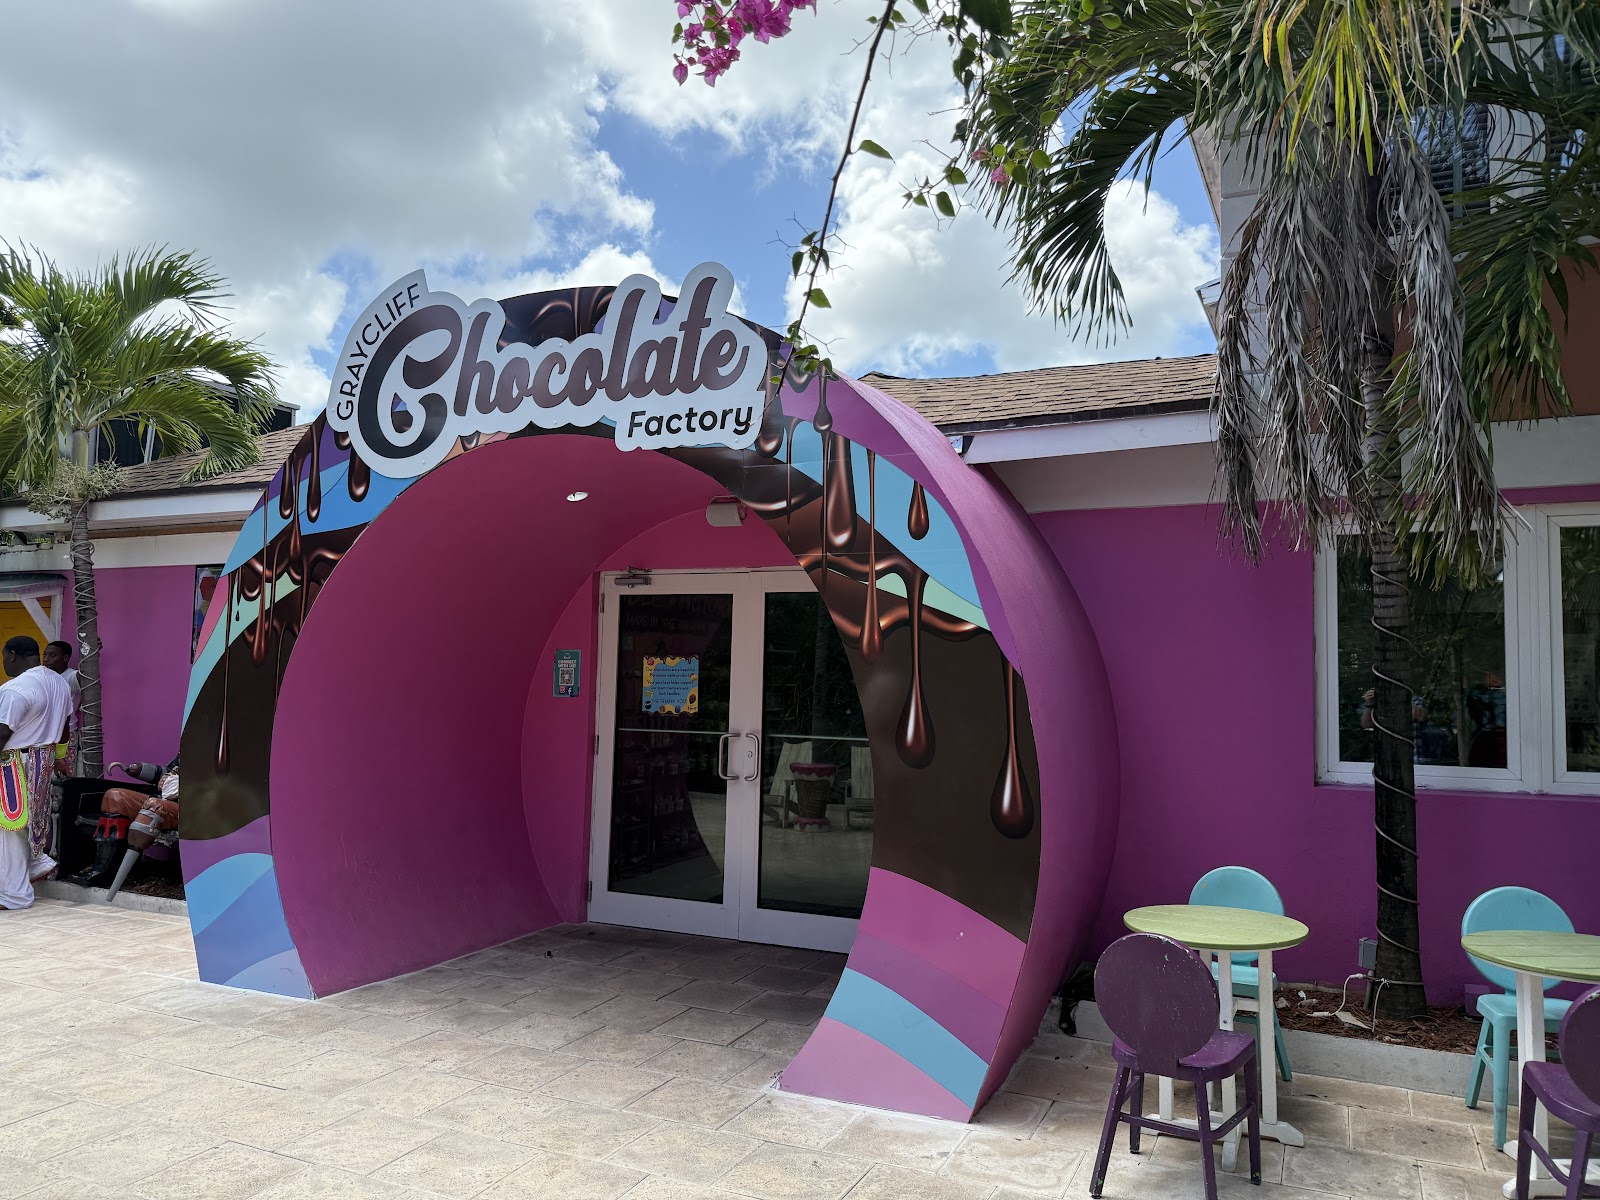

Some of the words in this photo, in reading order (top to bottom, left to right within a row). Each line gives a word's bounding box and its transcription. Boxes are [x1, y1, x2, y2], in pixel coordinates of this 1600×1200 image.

[336, 282, 420, 421] GRAYCLIFF
[357, 275, 750, 459] Chocolate
[626, 405, 754, 438] Factory
